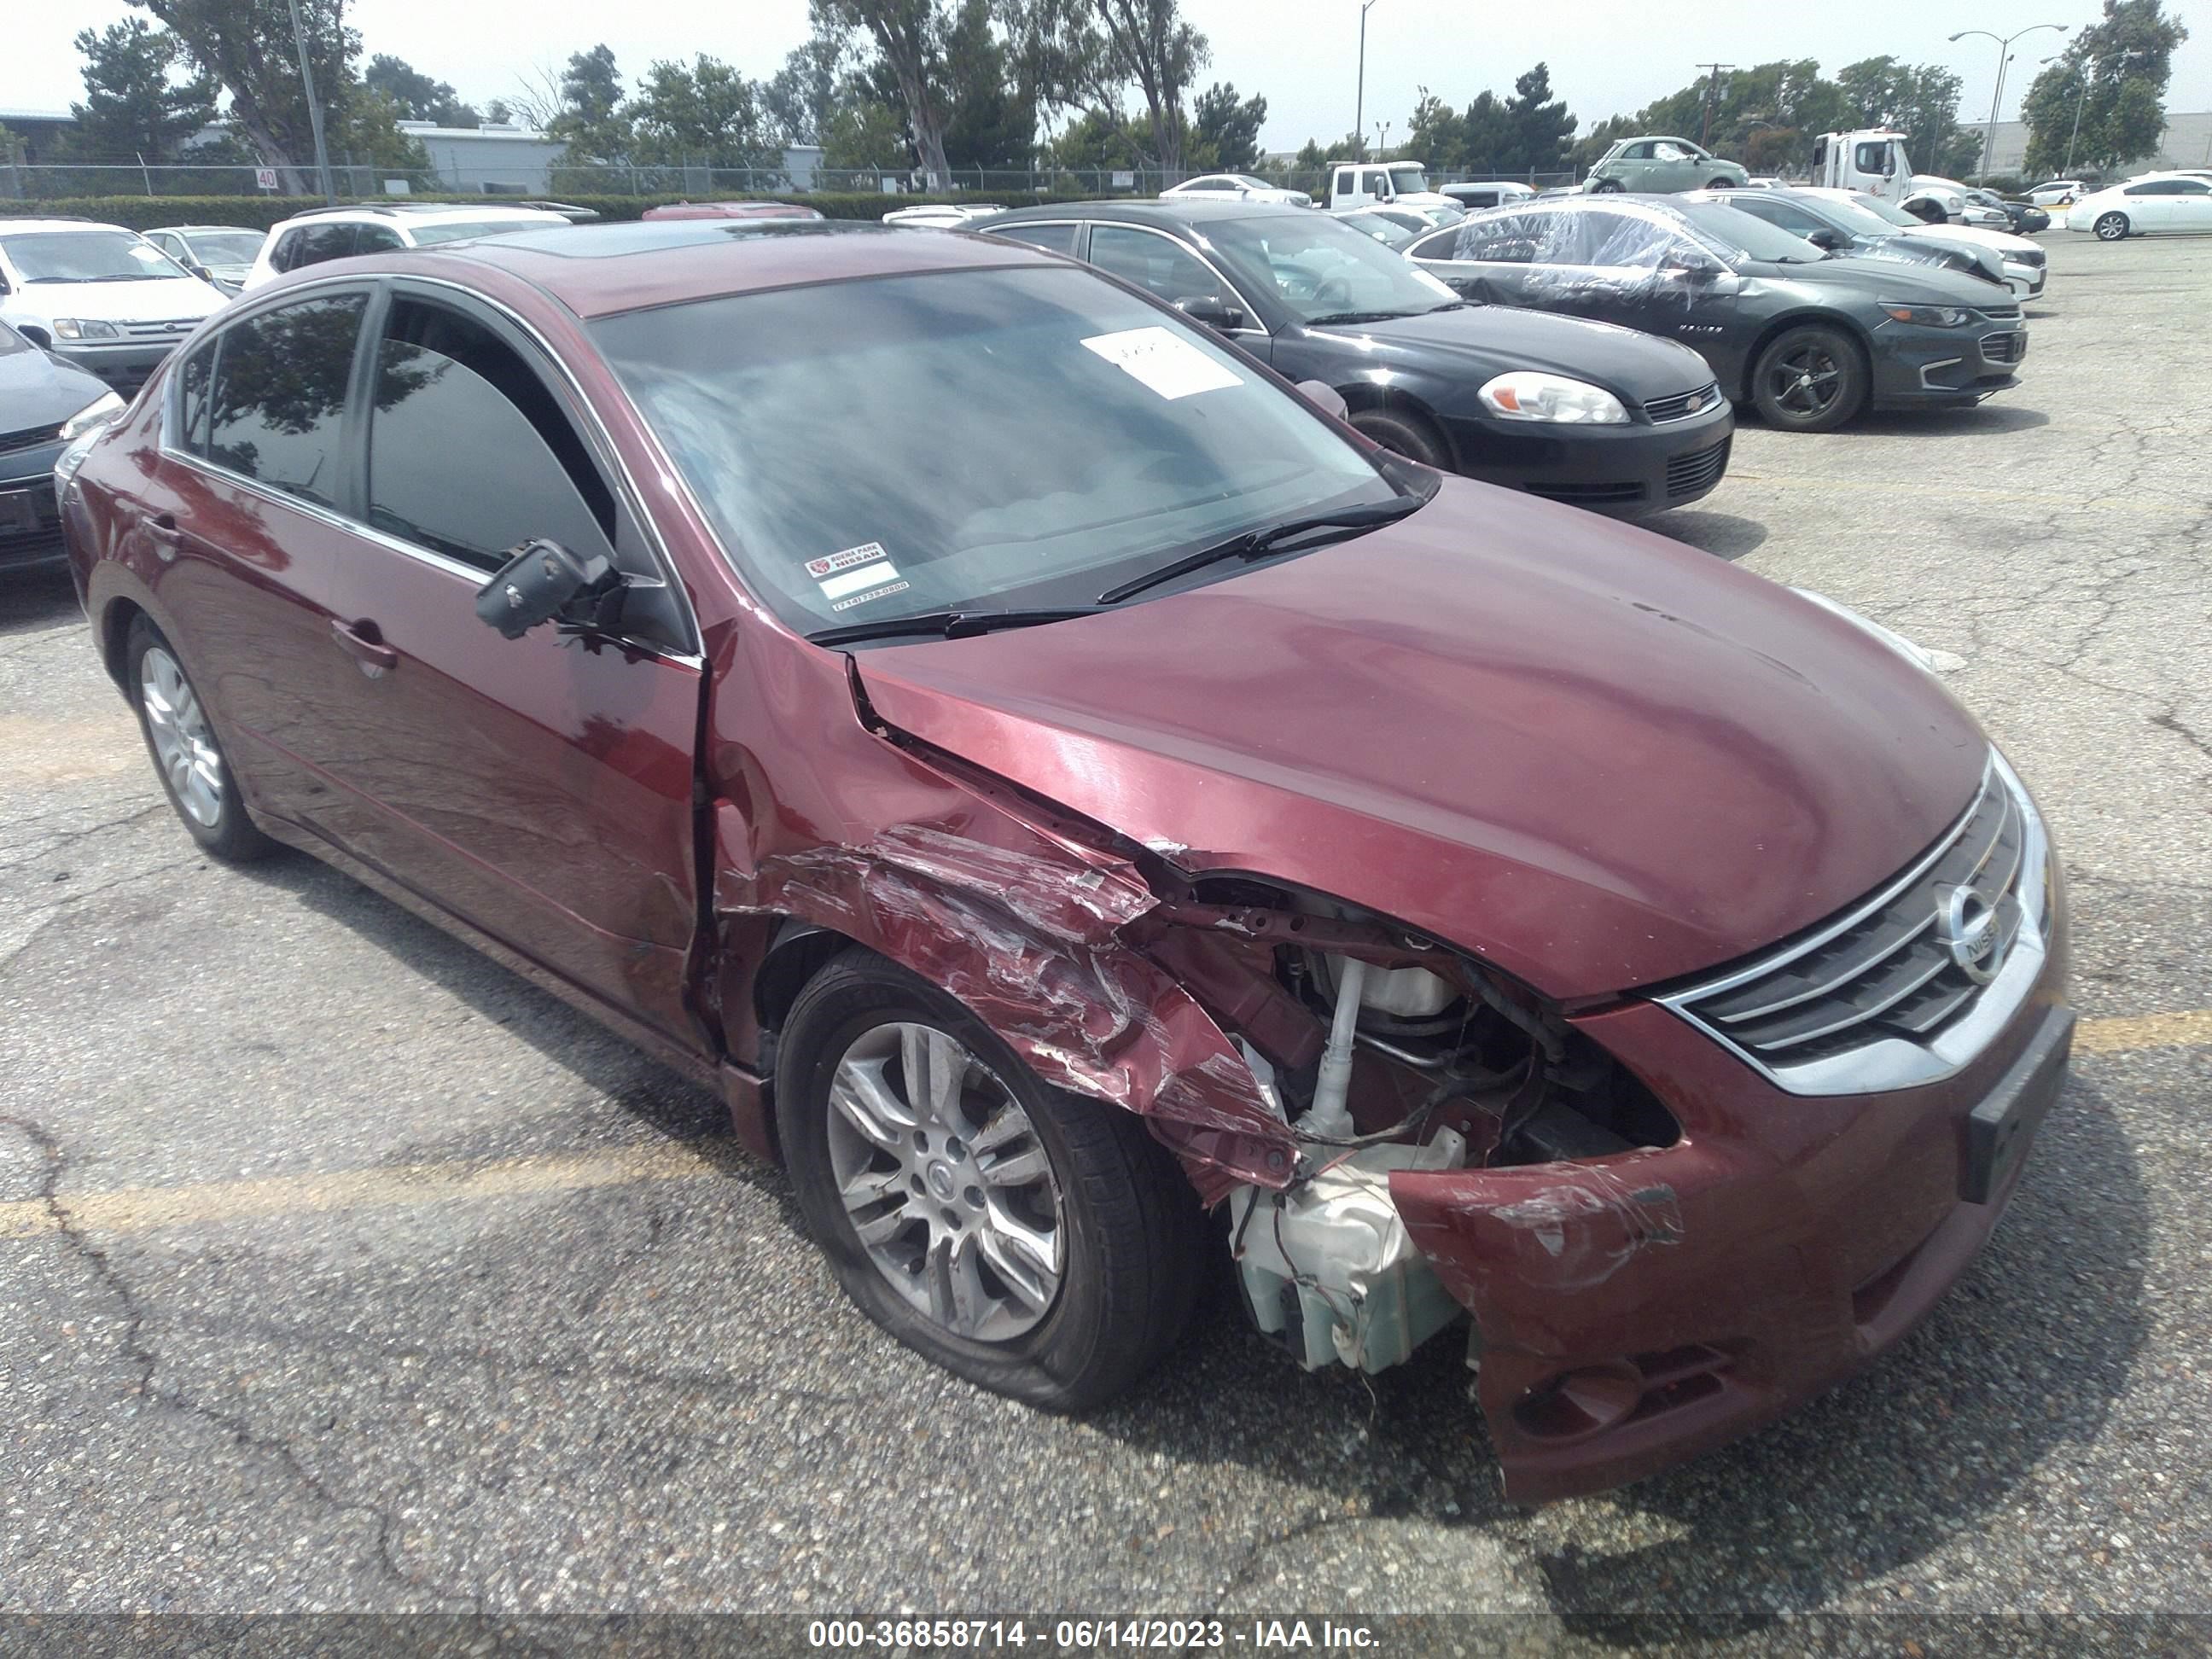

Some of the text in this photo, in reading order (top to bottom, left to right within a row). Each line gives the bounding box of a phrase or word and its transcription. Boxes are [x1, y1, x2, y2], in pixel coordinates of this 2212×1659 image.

[259, 171, 275, 186] 40
[858, 545, 877, 556] PARK
[835, 550, 881, 568] NISSAN
